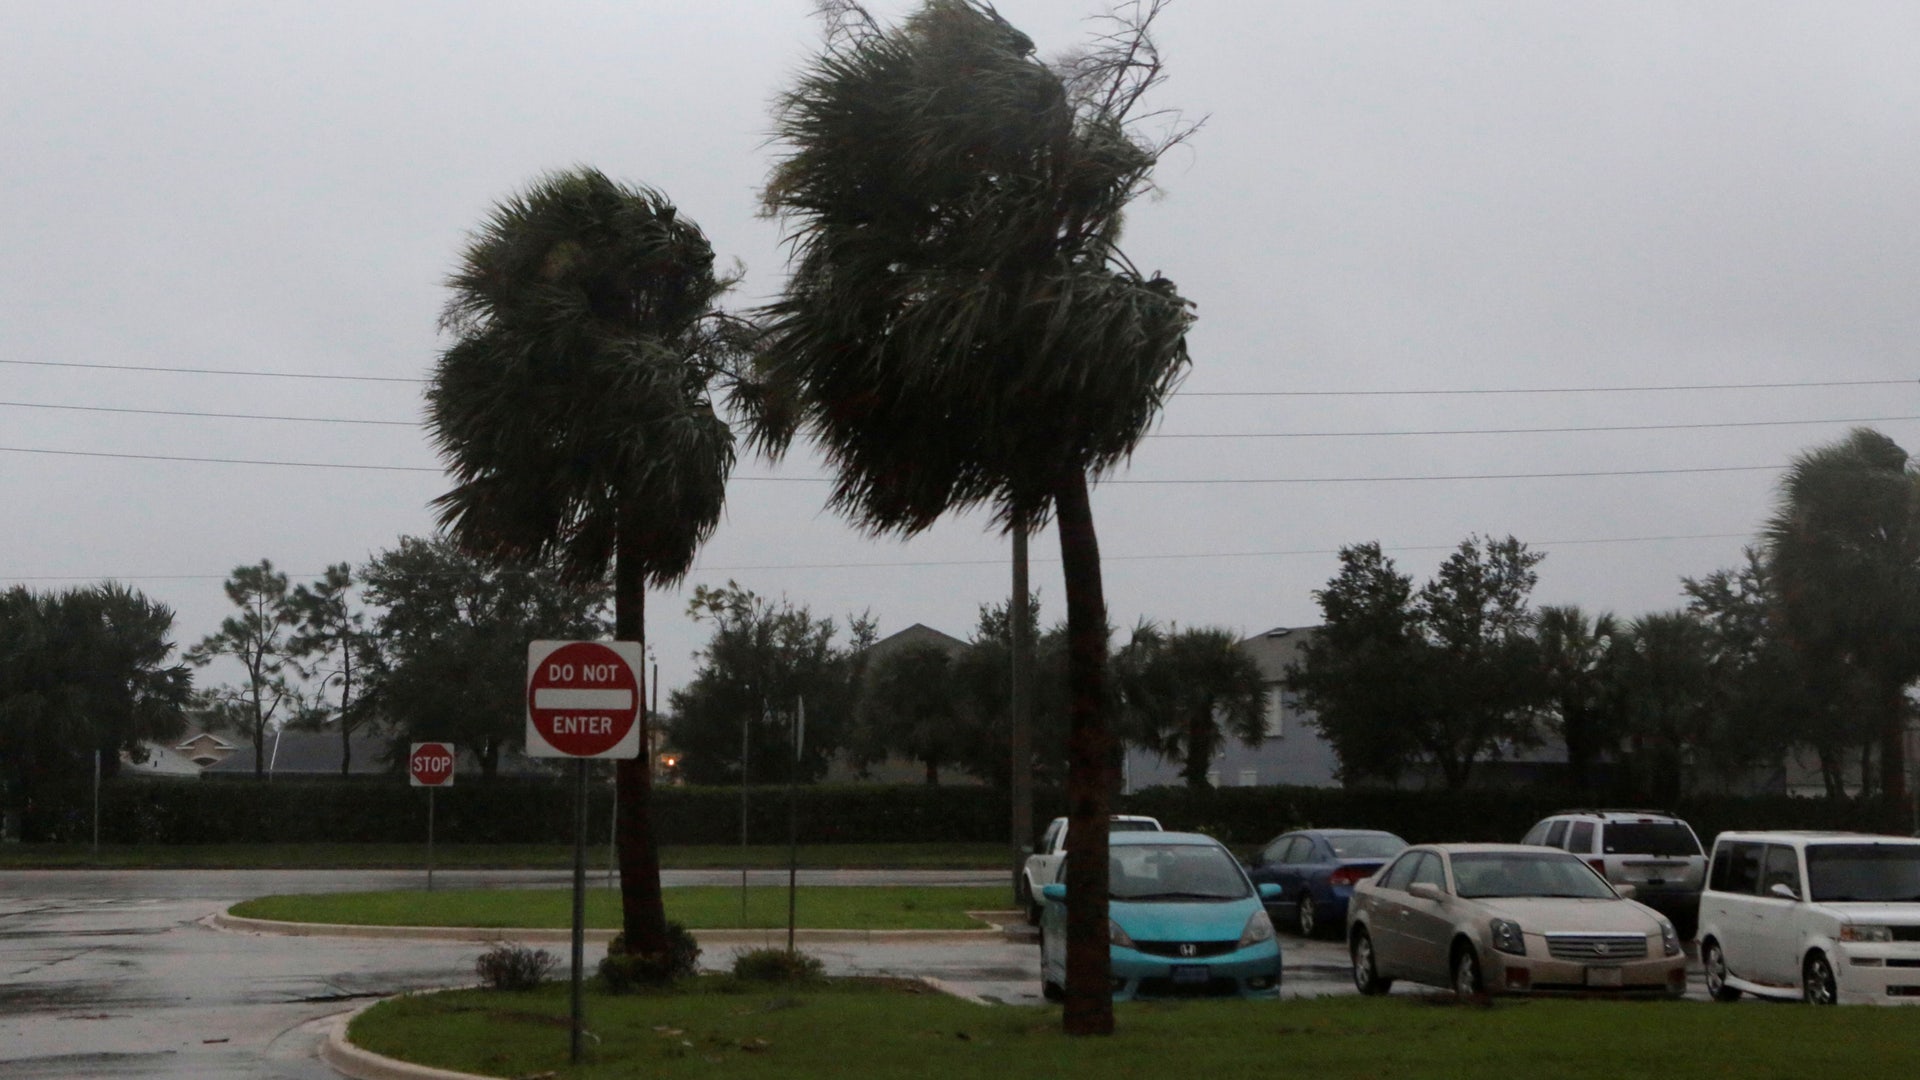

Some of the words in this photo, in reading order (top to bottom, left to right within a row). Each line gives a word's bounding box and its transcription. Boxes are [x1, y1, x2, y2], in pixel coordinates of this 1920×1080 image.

[549, 664, 574, 682] DO
[583, 664, 619, 682] NOT
[553, 716, 612, 734] ENTER
[413, 756, 451, 772] STOP
